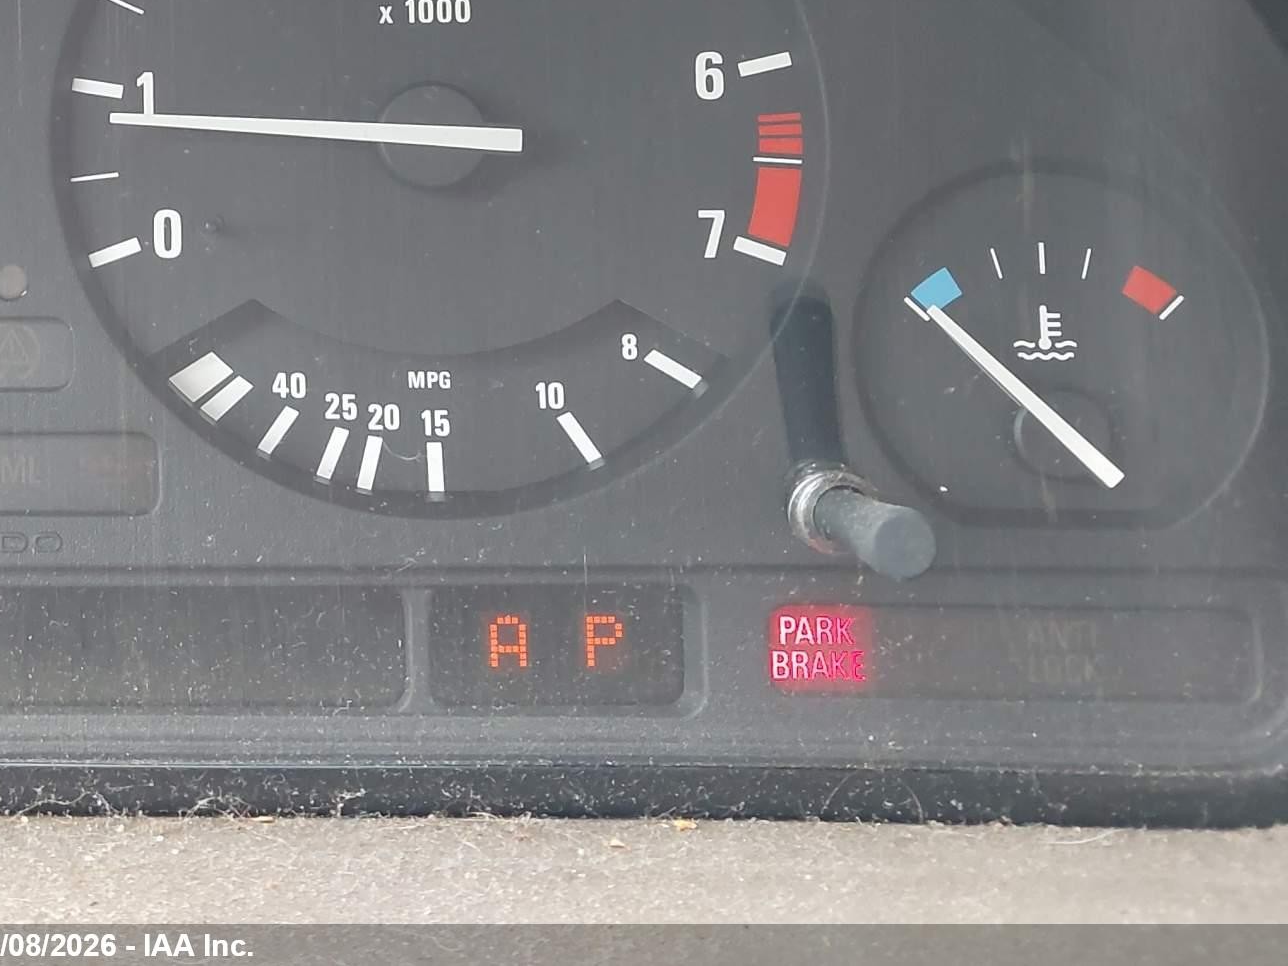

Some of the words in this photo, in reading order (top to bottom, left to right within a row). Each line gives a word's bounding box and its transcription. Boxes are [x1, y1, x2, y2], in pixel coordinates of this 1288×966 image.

[379, 4, 393, 25] x
[695, 52, 724, 100] 6
[136, 72, 154, 115] 1
[153, 209, 183, 260] 0
[697, 210, 726, 259] 7
[621, 334, 638, 361] 8
[272, 372, 307, 399] 40
[407, 371, 452, 391] MPG
[324, 394, 359, 421] 25
[535, 383, 565, 410] 10
[367, 405, 400, 431] 20
[420, 410, 451, 437] 15
[488, 613, 528, 668] A
[585, 614, 623, 668] P
[779, 616, 856, 645] PARK
[772, 650, 866, 681] BRAKE
